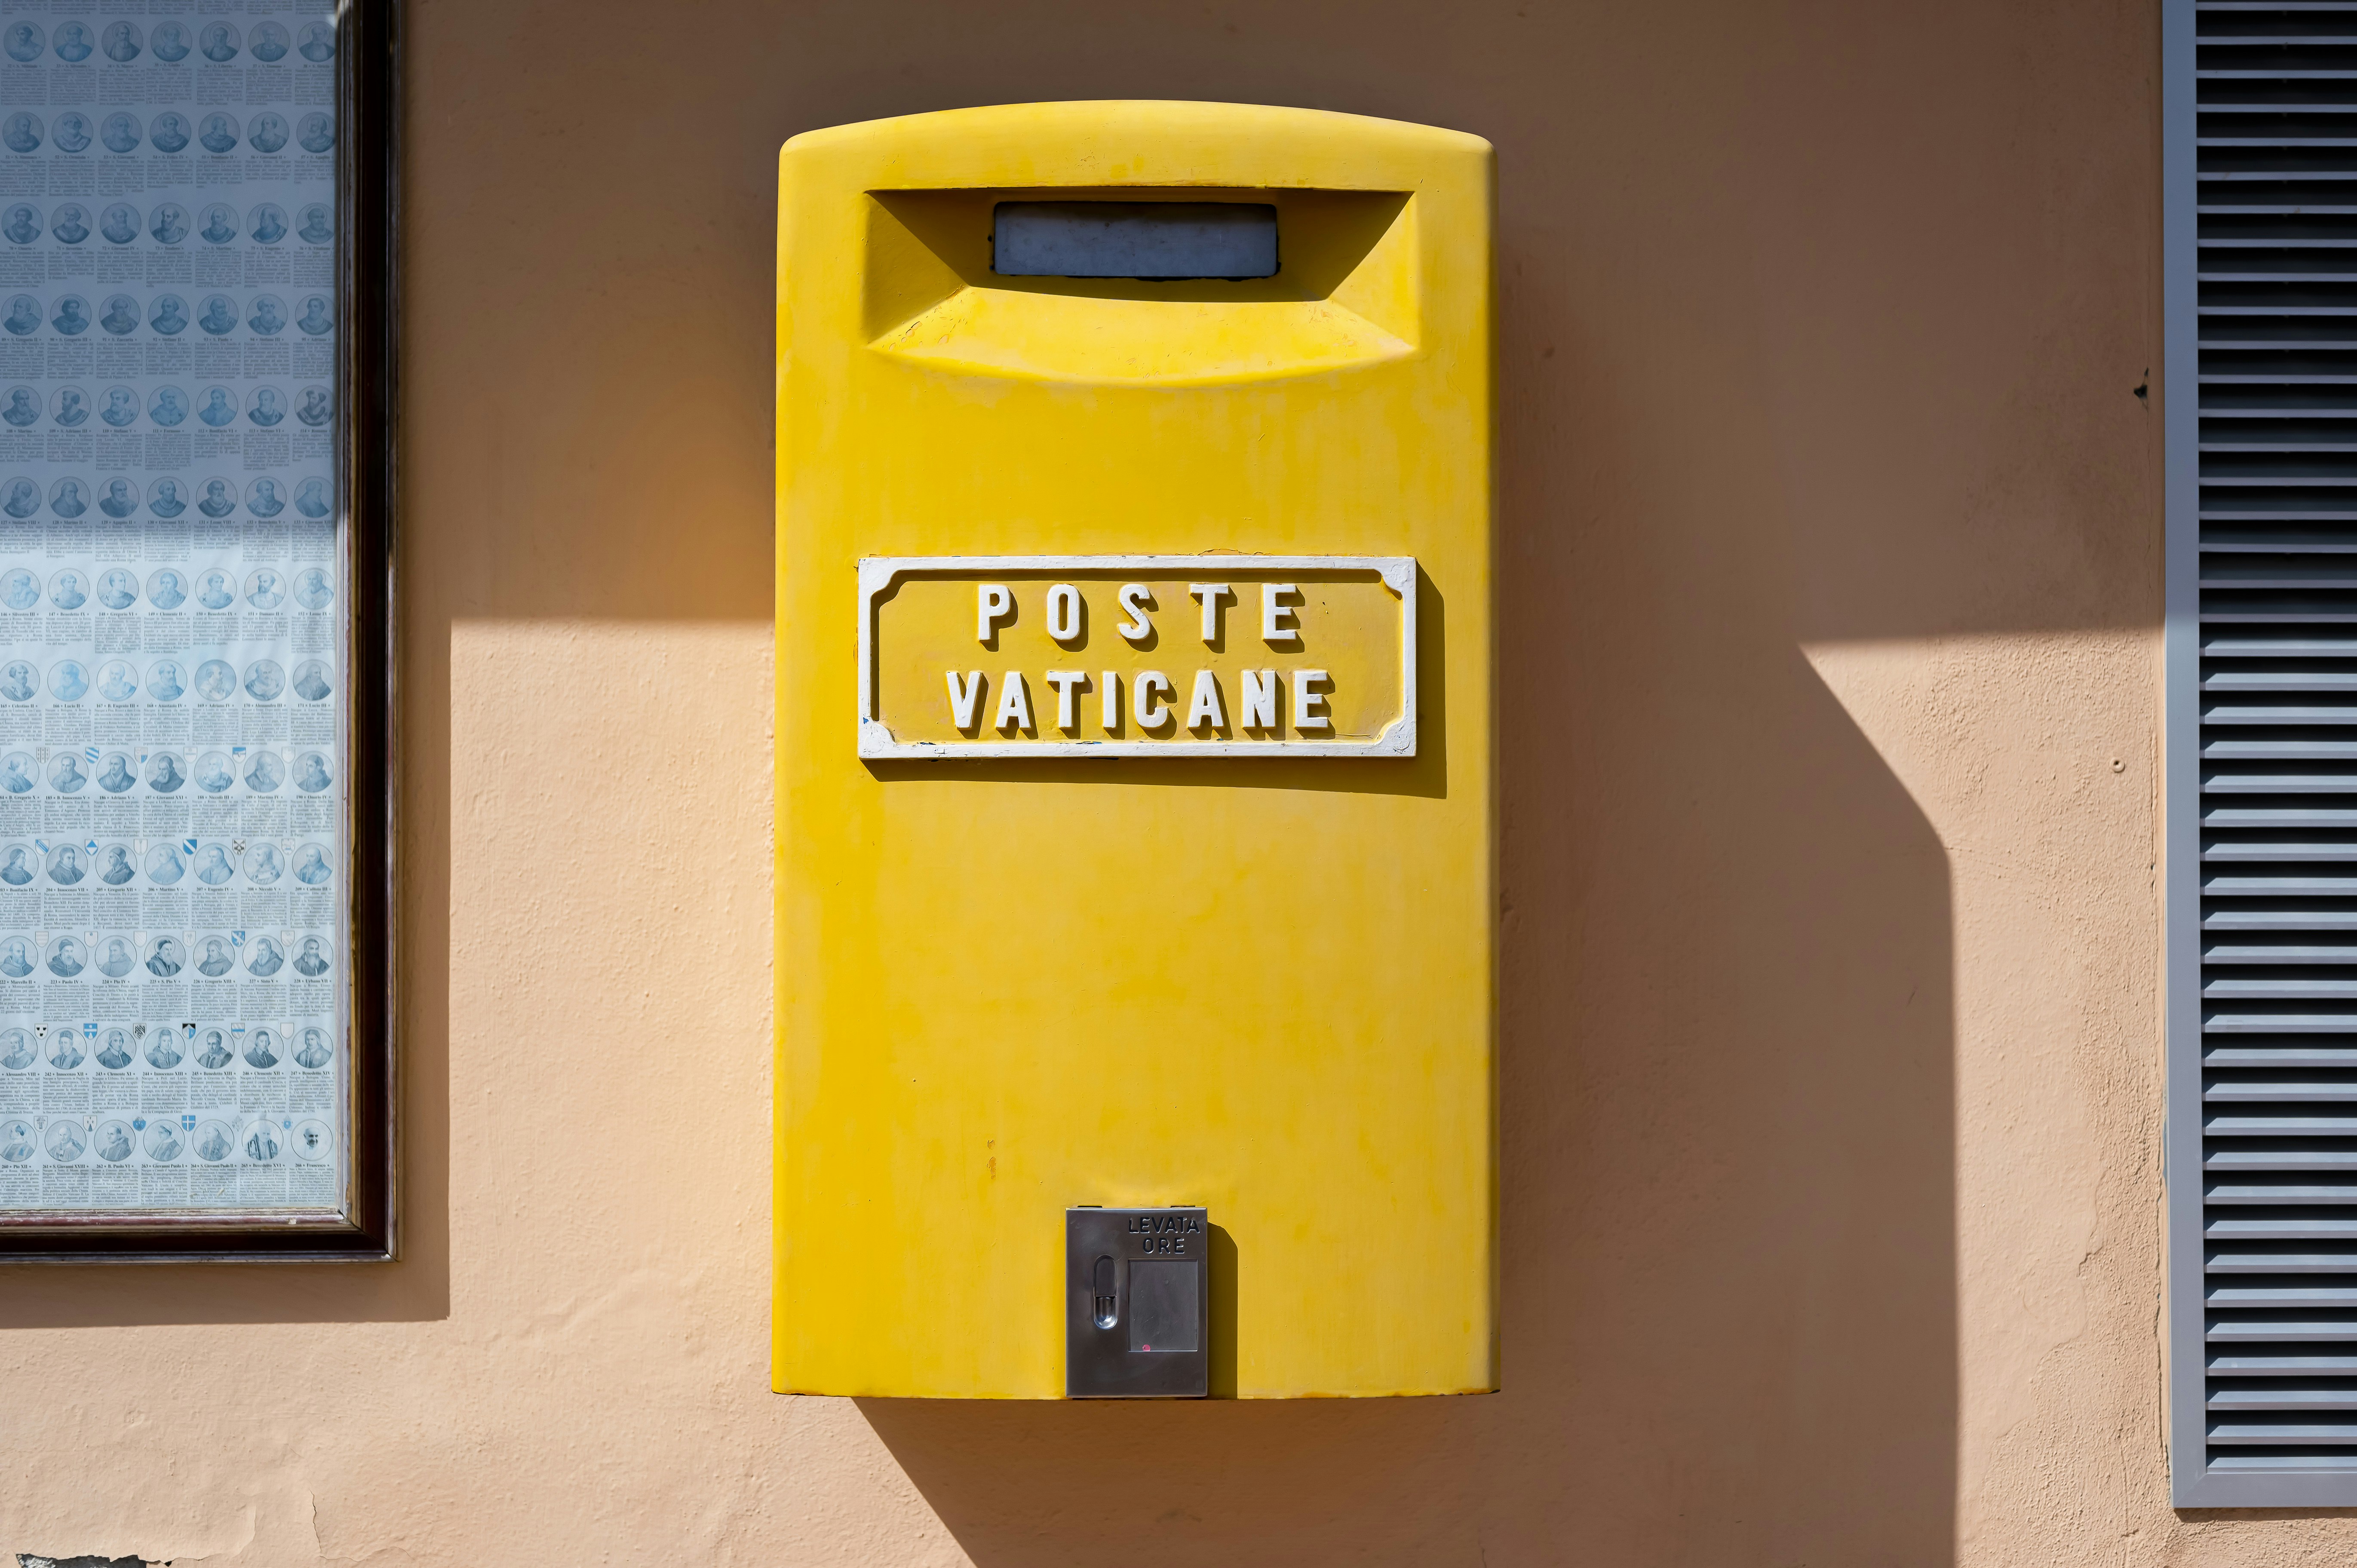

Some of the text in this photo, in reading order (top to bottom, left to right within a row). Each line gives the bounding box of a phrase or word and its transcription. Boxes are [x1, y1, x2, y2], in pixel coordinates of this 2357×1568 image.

[977, 584, 1298, 641] POSTE
[946, 670, 1329, 730] VATICANE
[1129, 1217, 1200, 1234] LEVATA
[1143, 1237, 1185, 1254] ORE
